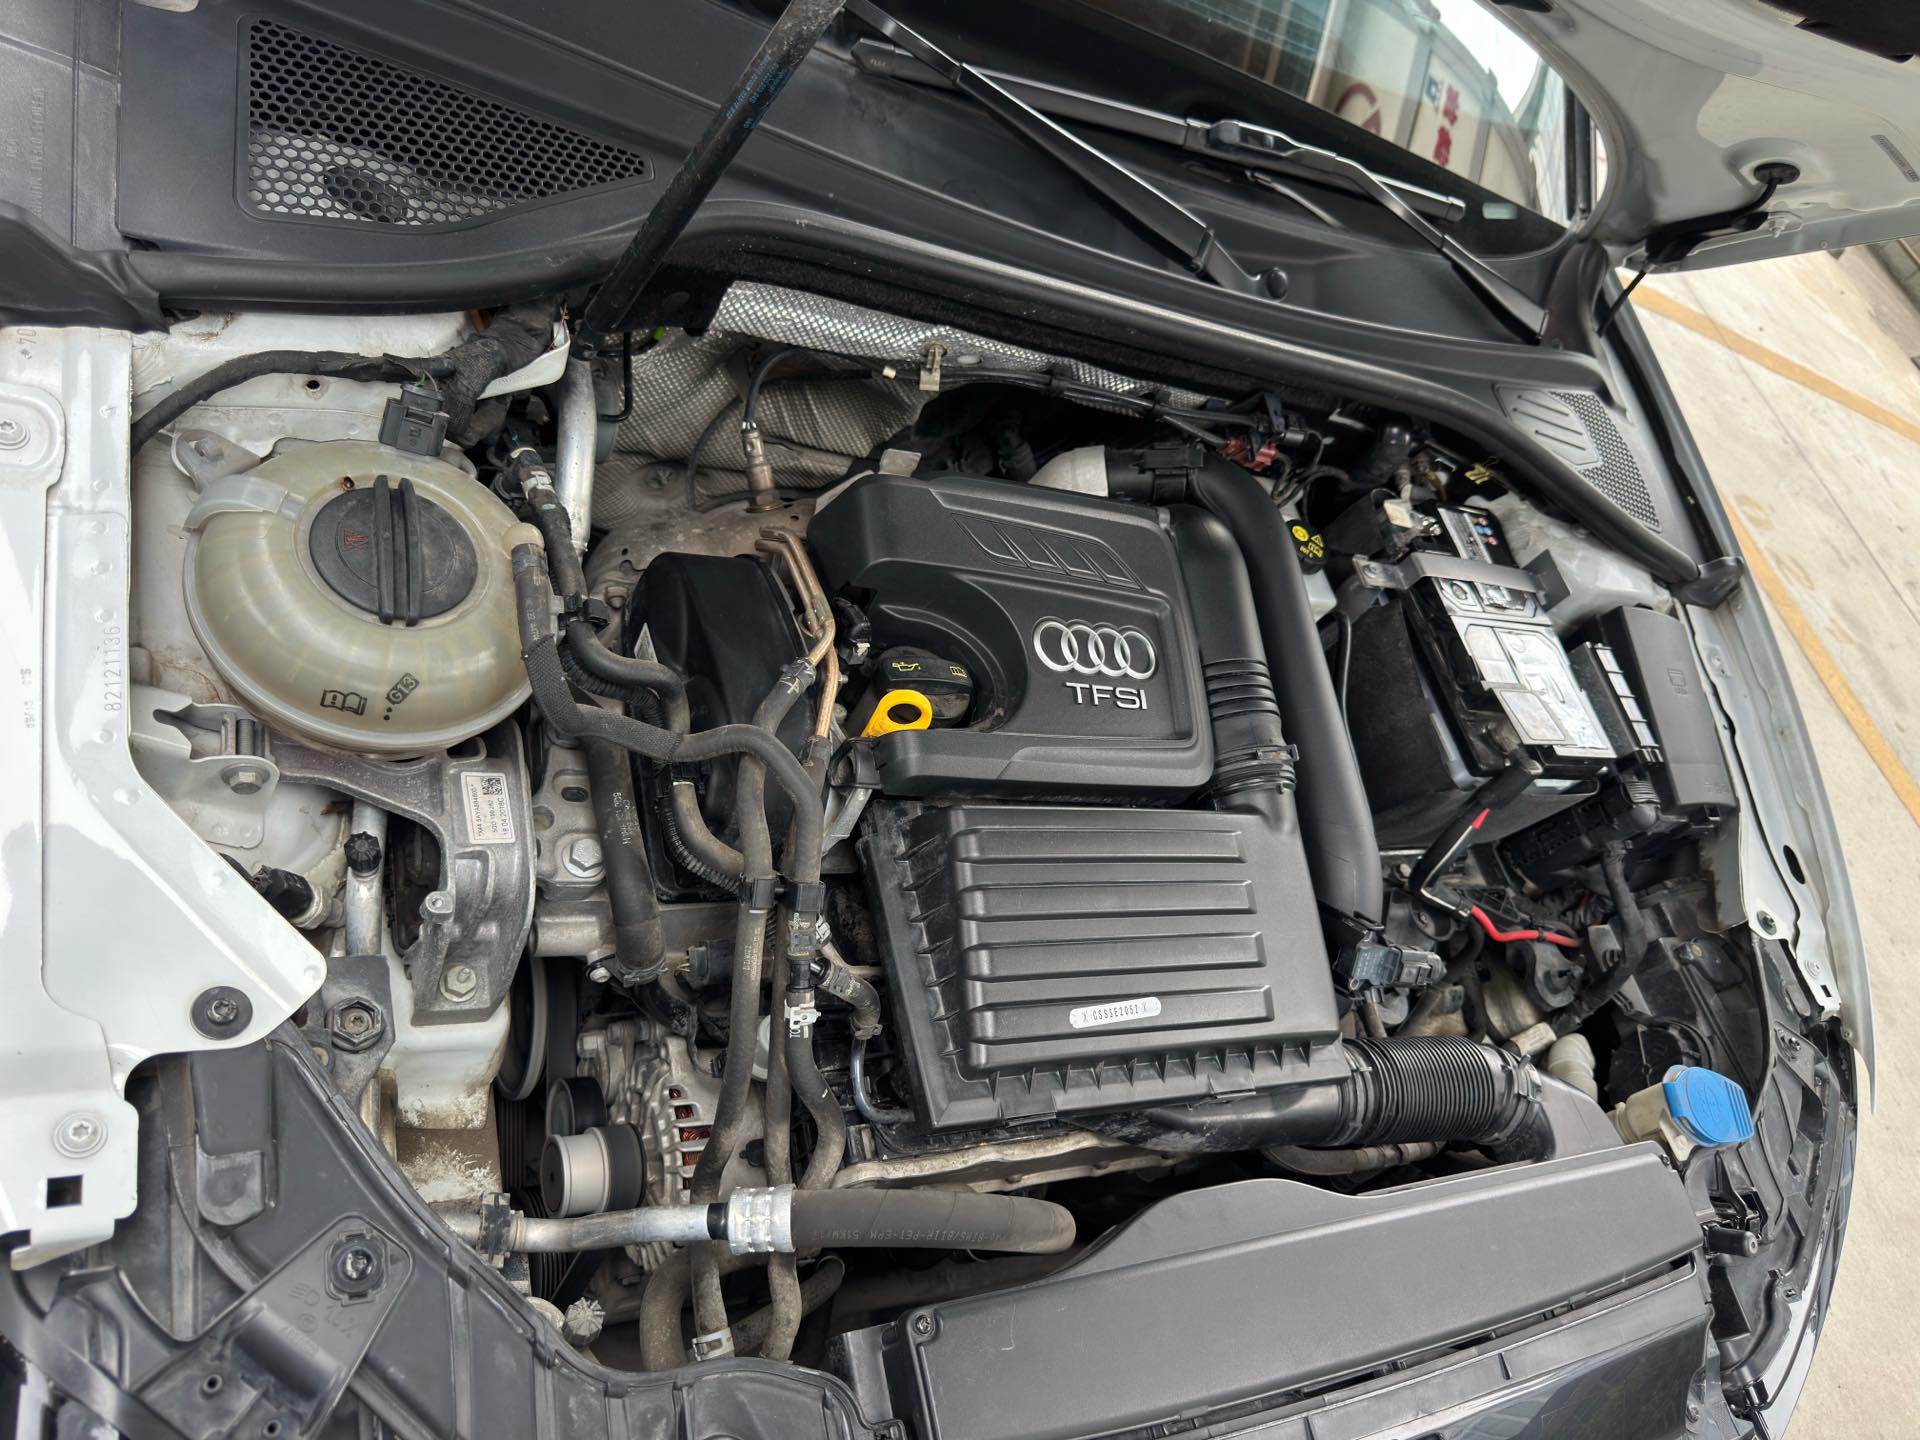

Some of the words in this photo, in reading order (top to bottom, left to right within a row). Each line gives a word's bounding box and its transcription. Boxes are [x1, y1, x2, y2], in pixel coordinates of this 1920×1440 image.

[103, 626, 121, 712] 82121136
[388, 676, 416, 702] G13
[1065, 681, 1147, 710] TFSI
